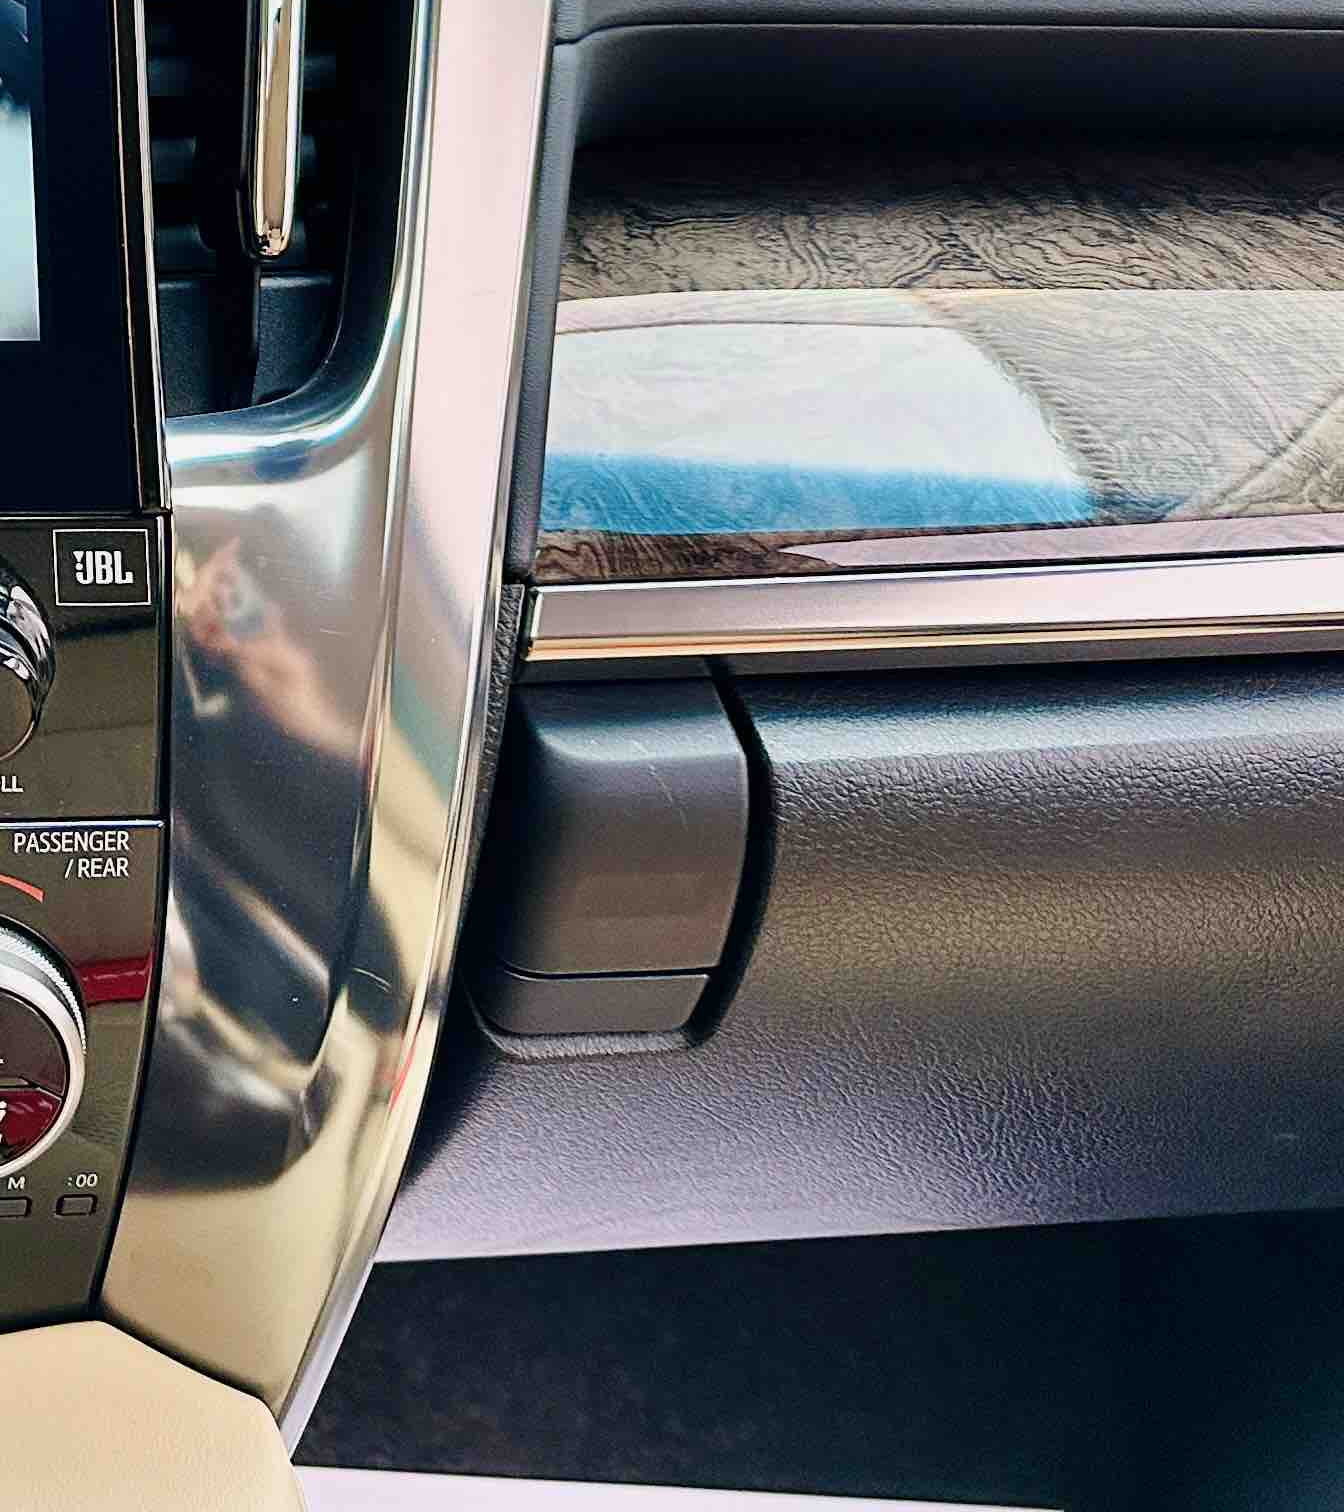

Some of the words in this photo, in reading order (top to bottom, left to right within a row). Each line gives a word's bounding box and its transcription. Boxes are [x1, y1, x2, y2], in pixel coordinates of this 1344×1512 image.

[73, 551, 134, 584] JBL
[13, 831, 129, 853] PASSENGER
[7, 1176, 26, 1190] M
[67, 1174, 98, 1188] :00
